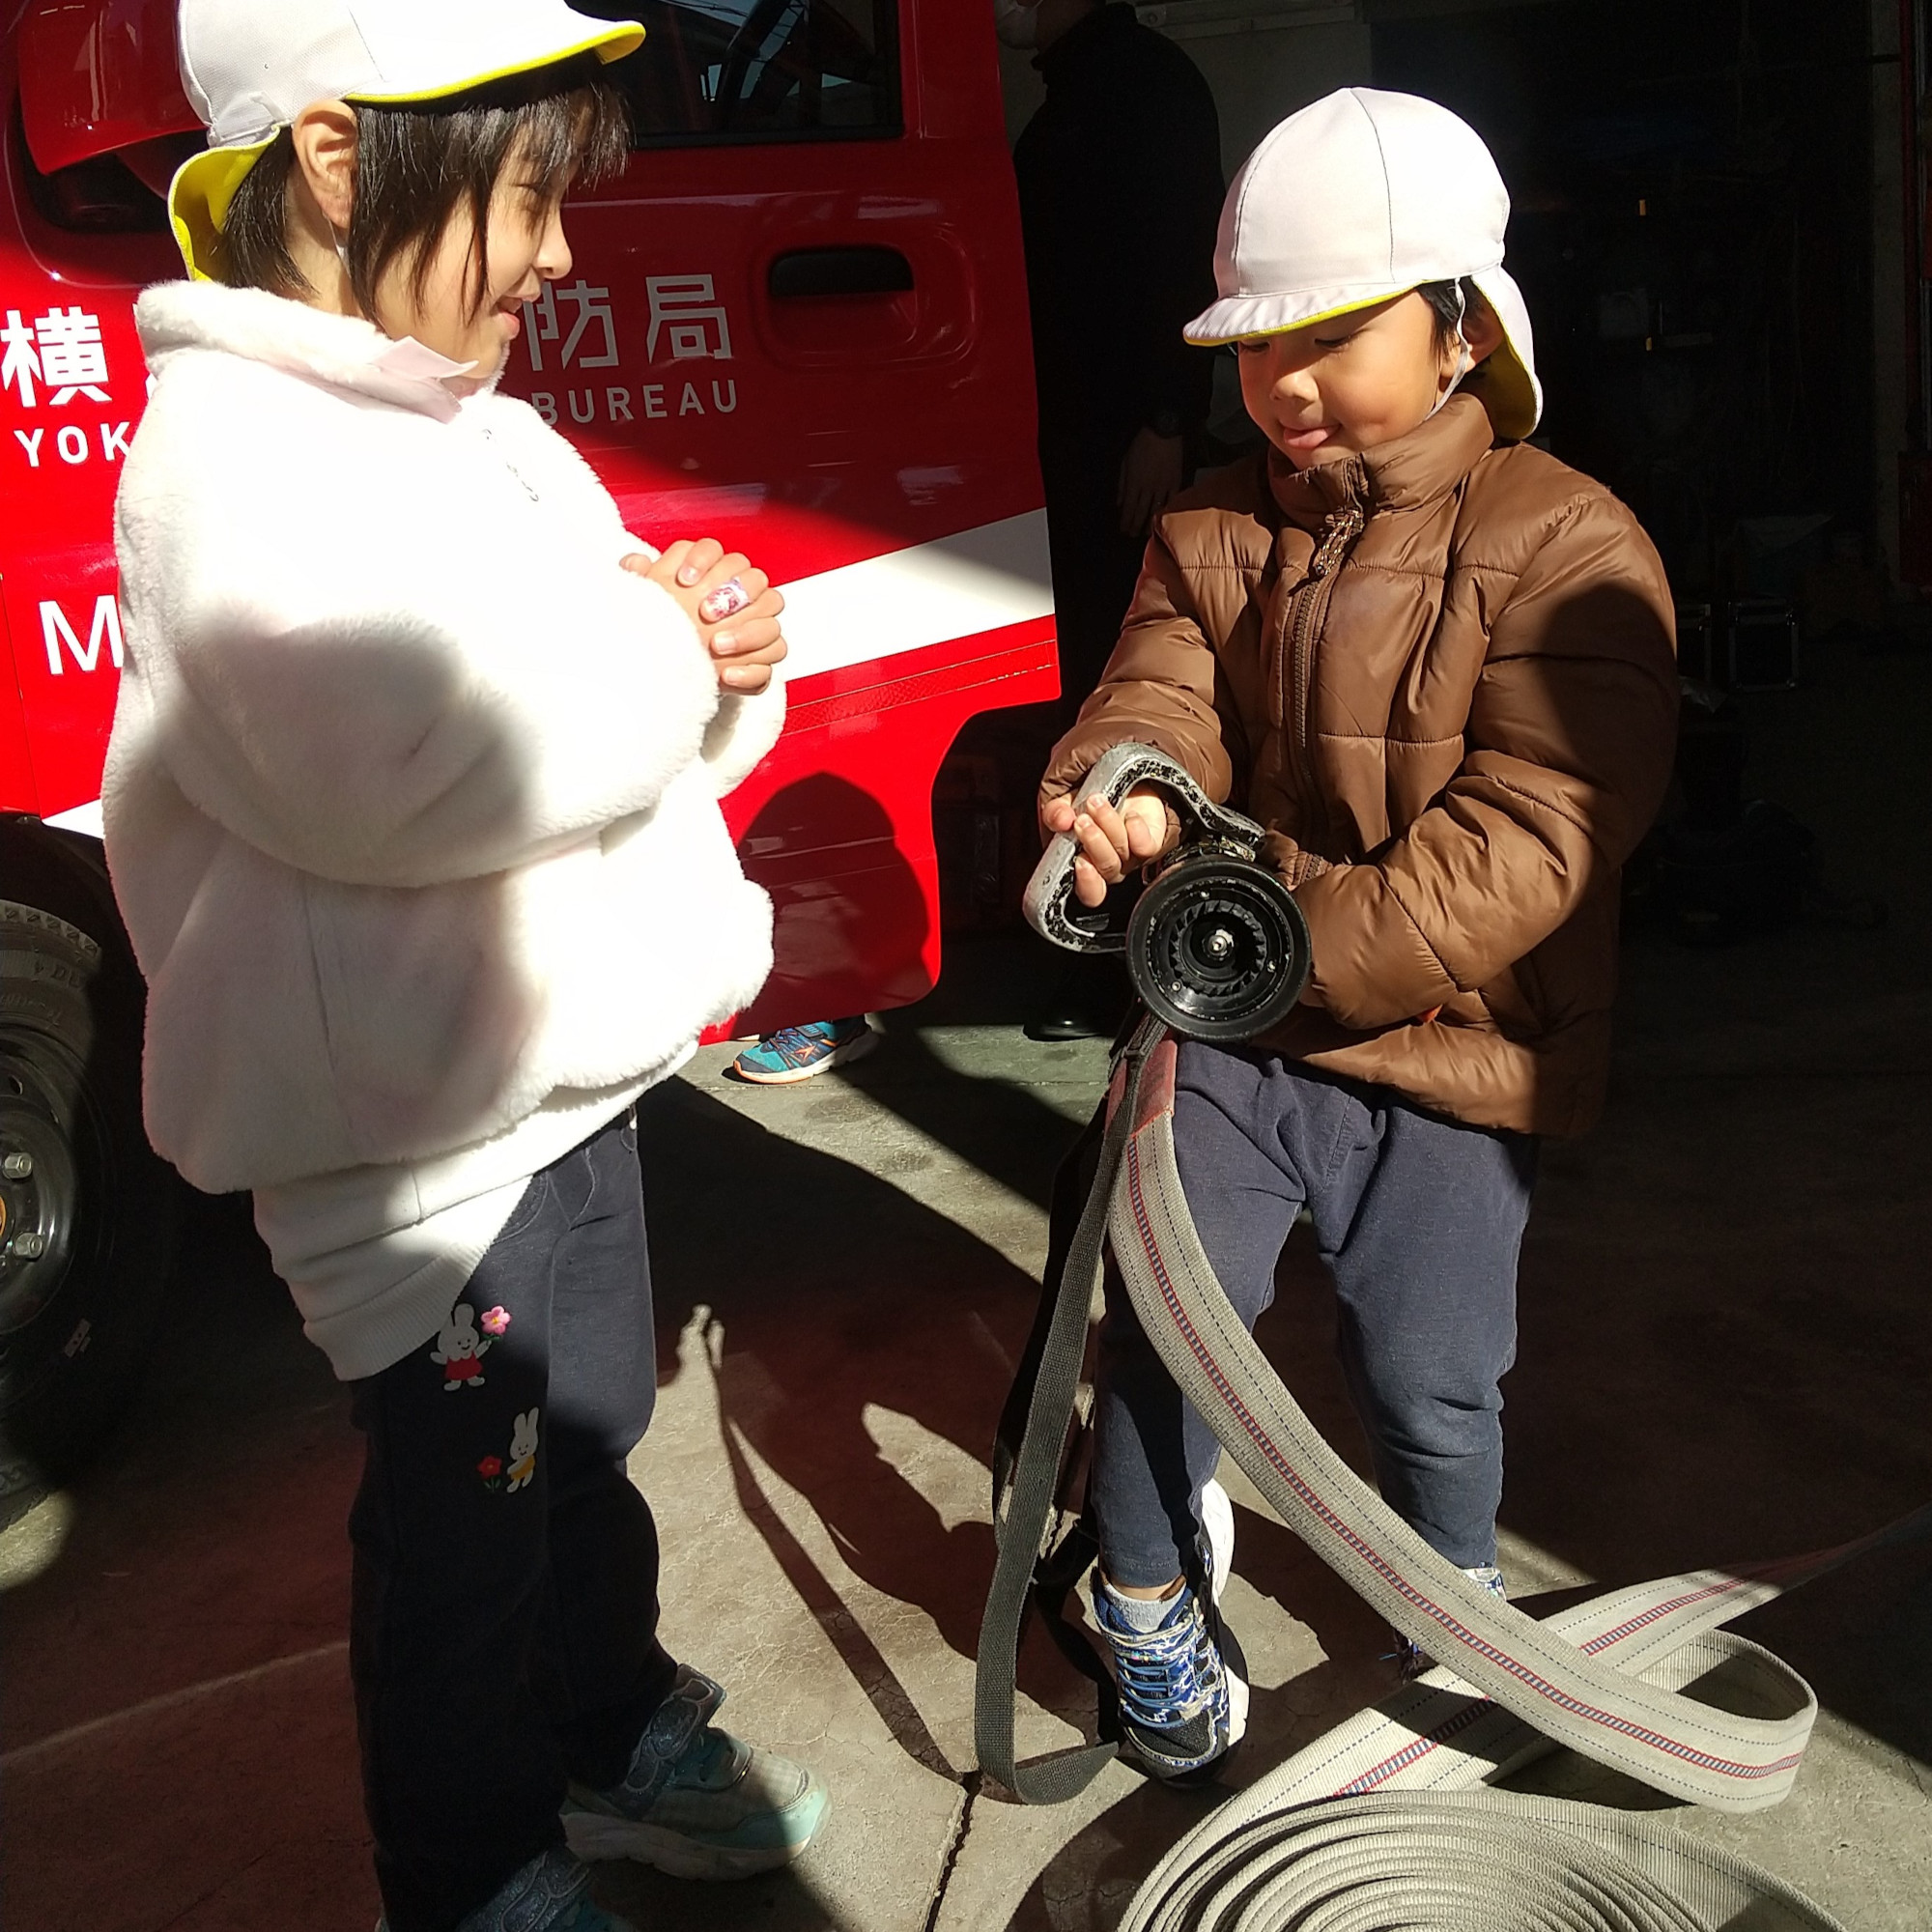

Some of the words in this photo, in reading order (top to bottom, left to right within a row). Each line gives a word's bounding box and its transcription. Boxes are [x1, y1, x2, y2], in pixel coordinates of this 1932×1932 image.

[0, 305, 157, 408] 横
[523, 273, 732, 372] 防局
[14, 421, 130, 468] YOK
[531, 379, 737, 426] BUREAU
[39, 594, 125, 676] M
